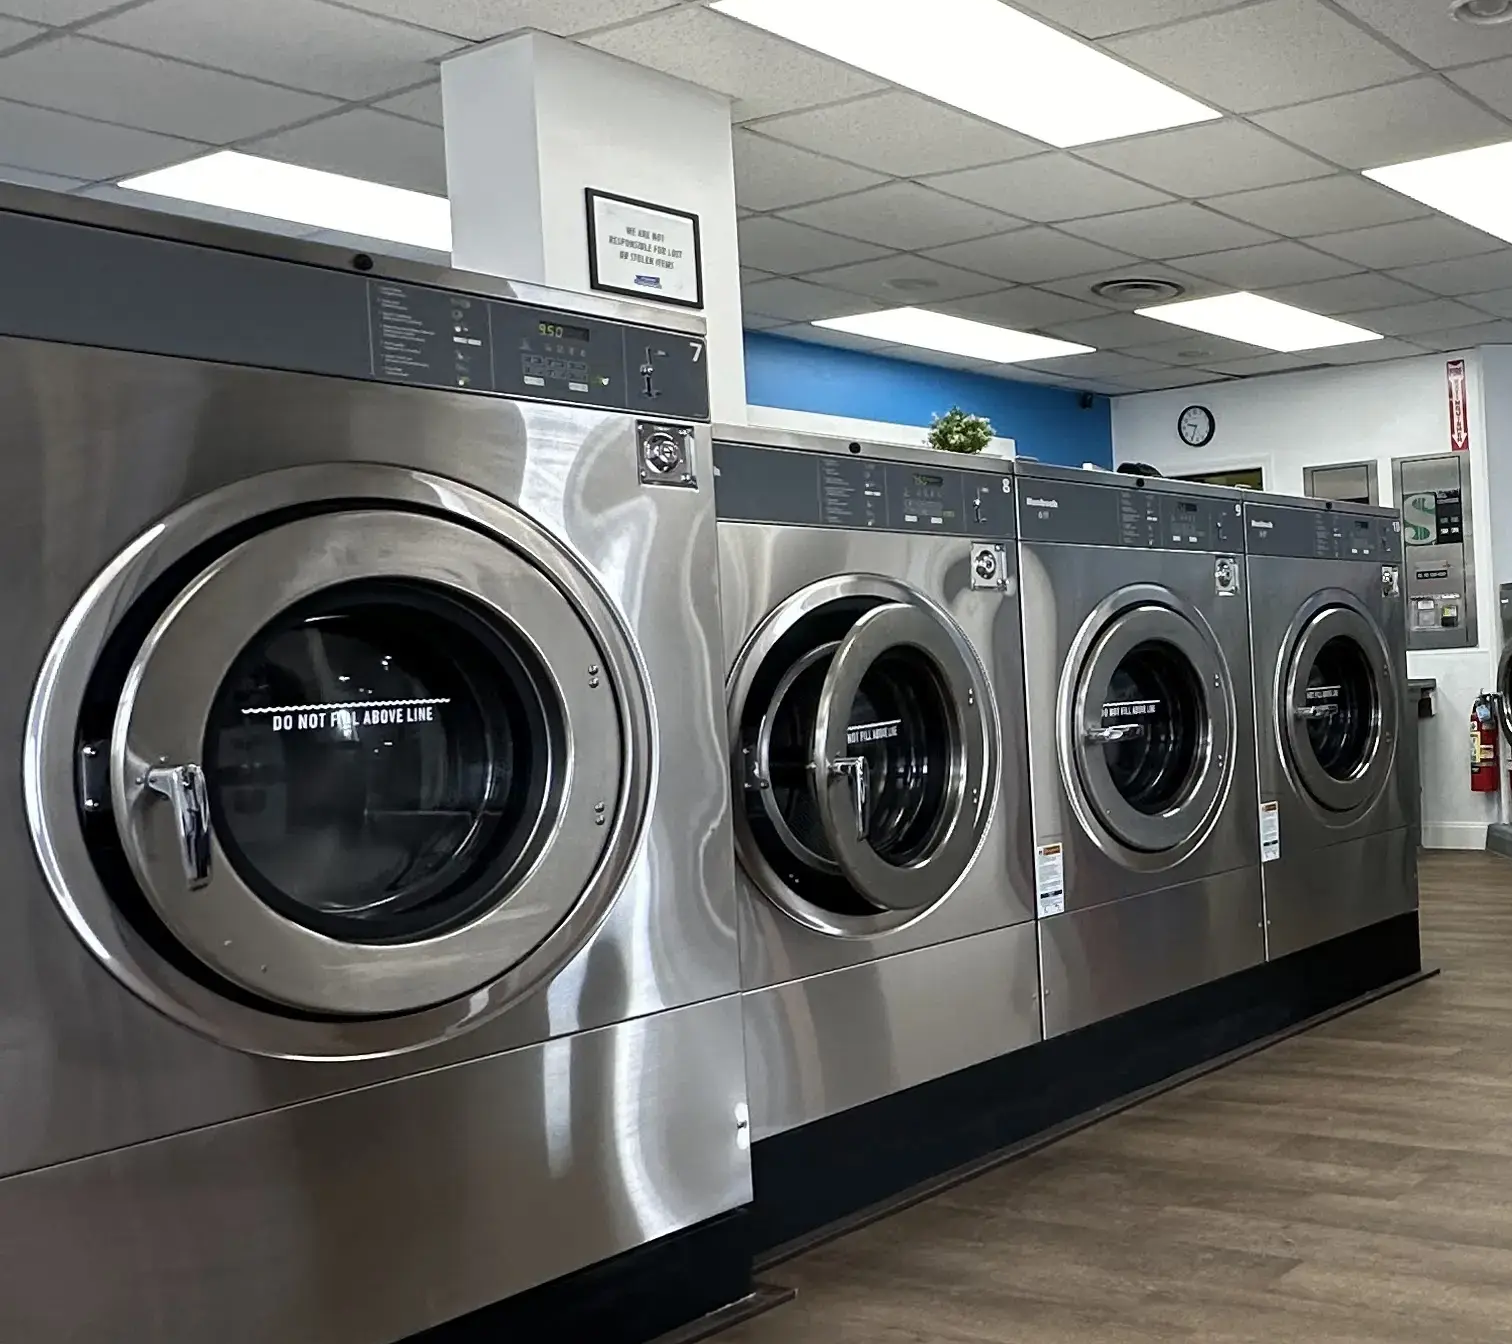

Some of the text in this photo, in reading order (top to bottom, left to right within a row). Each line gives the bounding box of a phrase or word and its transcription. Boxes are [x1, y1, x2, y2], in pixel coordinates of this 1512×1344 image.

[690, 342, 702, 362] 7
[1002, 478, 1011, 494] 8
[1234, 504, 1241, 517] 9
[273, 706, 433, 731] DO NOT FILL ABOVE LINE
